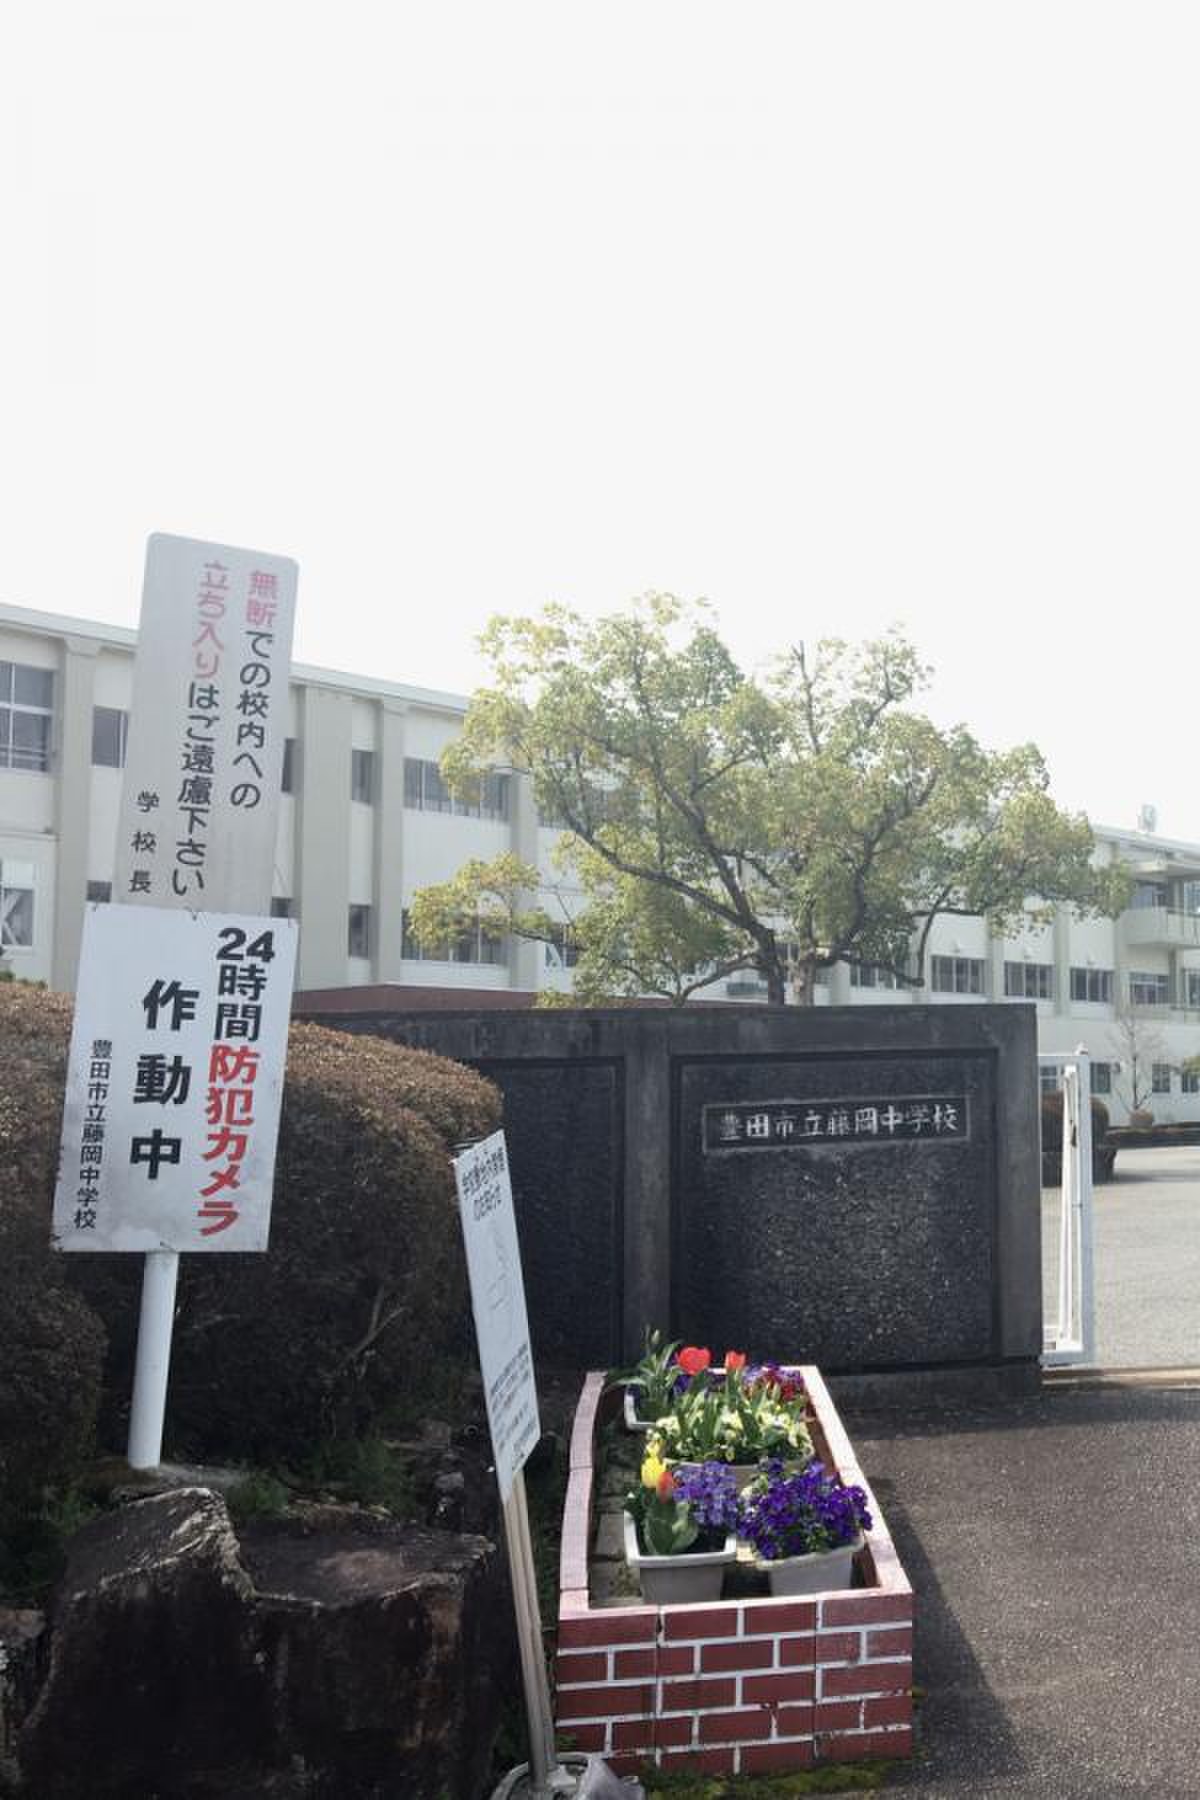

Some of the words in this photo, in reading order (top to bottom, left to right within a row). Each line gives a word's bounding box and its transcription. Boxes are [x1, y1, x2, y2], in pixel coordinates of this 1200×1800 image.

[172, 560, 230, 896] 立ち入りはご遠慮下さい
[231, 569, 279, 809] 無断での校内への
[128, 790, 160, 894] 学校長
[73, 1039, 113, 1230] 豊田市立藤岡中学校
[129, 978, 200, 1181] 作動中
[197, 926, 276, 1237] 24時間防犯カメラ
